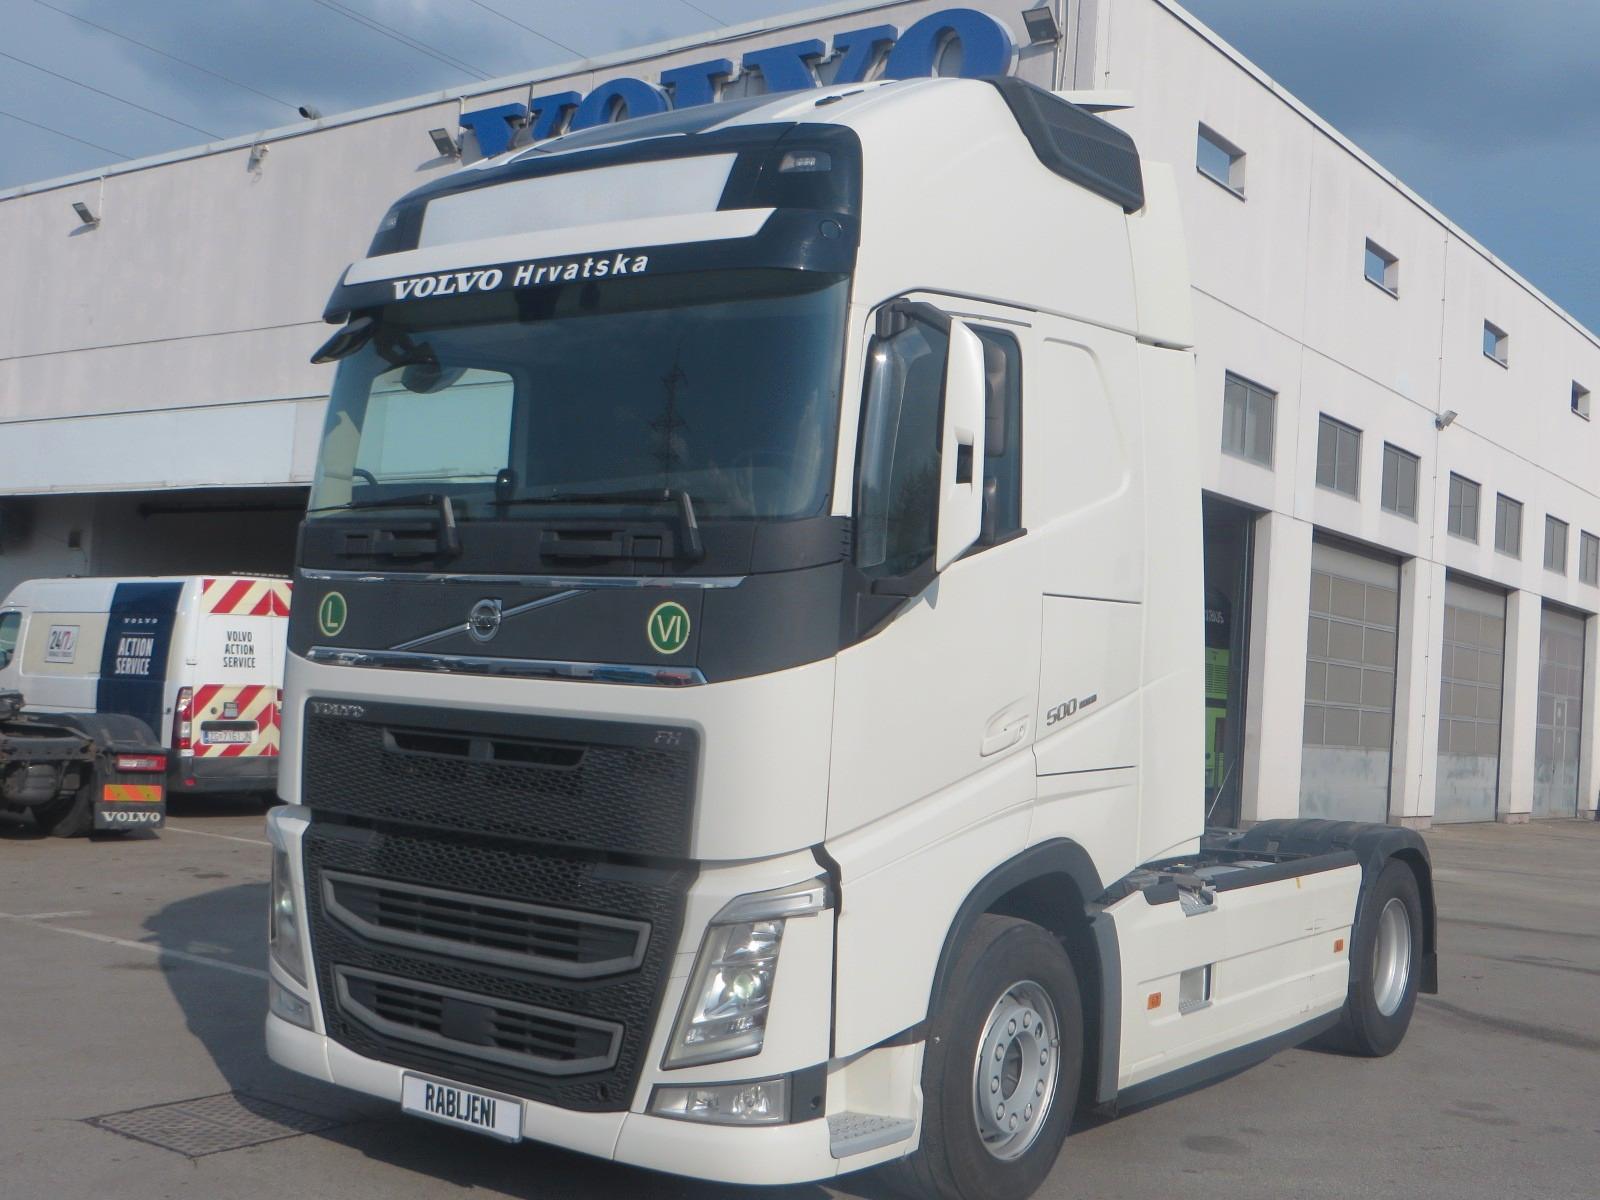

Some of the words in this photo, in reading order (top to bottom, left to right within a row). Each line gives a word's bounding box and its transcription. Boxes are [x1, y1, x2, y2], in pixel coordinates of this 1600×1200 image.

[393, 268, 503, 300] VOLVO
[513, 253, 649, 287] Hrvatska
[327, 600, 339, 628] L
[226, 630, 253, 642] VOLVO
[657, 614, 682, 643] VI
[117, 637, 155, 656] ACTION
[225, 643, 255, 655] ACTION
[114, 657, 151, 676] SERVICE
[223, 656, 256, 669] SERVICE
[1046, 698, 1077, 726] 500
[101, 811, 161, 822] VOLVO
[425, 1083, 497, 1129] RABLJENI
